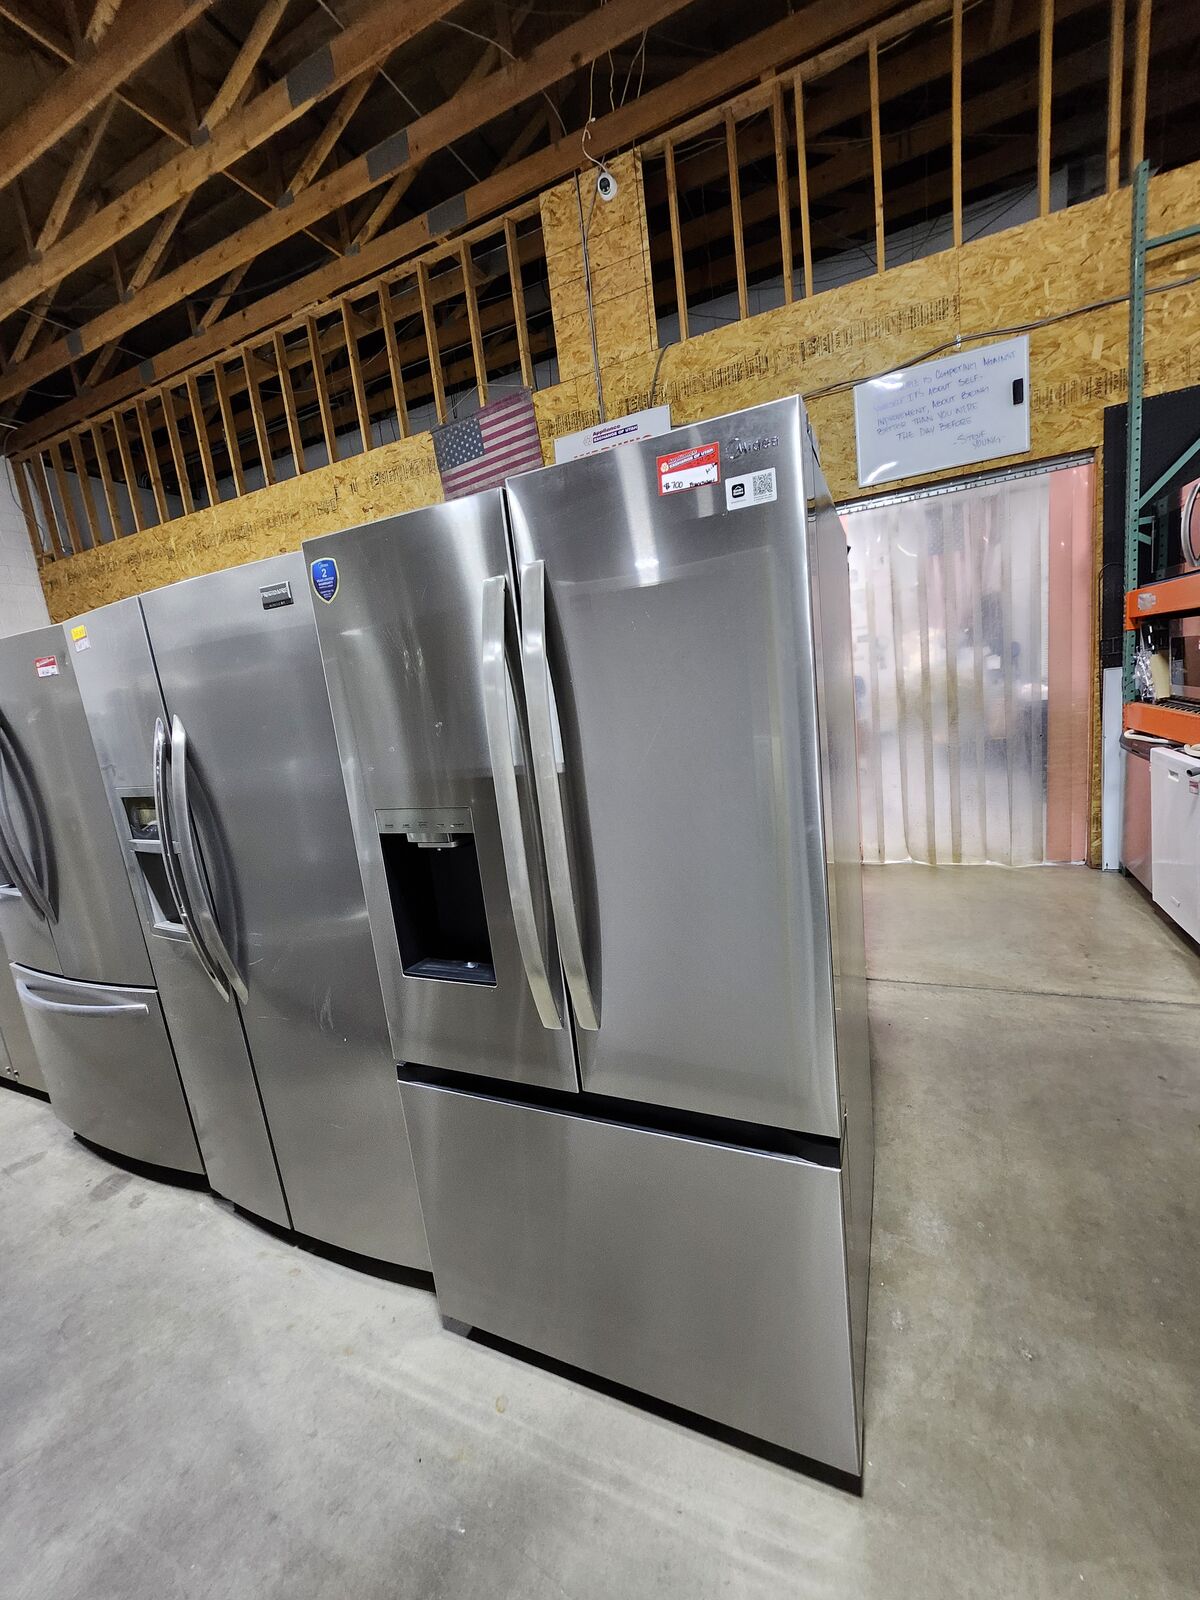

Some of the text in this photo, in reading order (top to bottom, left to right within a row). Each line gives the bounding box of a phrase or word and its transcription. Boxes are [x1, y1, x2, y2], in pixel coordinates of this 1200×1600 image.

[928, 383, 951, 396] ABOUT
[932, 395, 955, 409] ABOUT
[592, 424, 621, 437] Appliance
[896, 430, 914, 441] THE
[919, 425, 935, 438] DAY
[321, 568, 327, 578] 2
